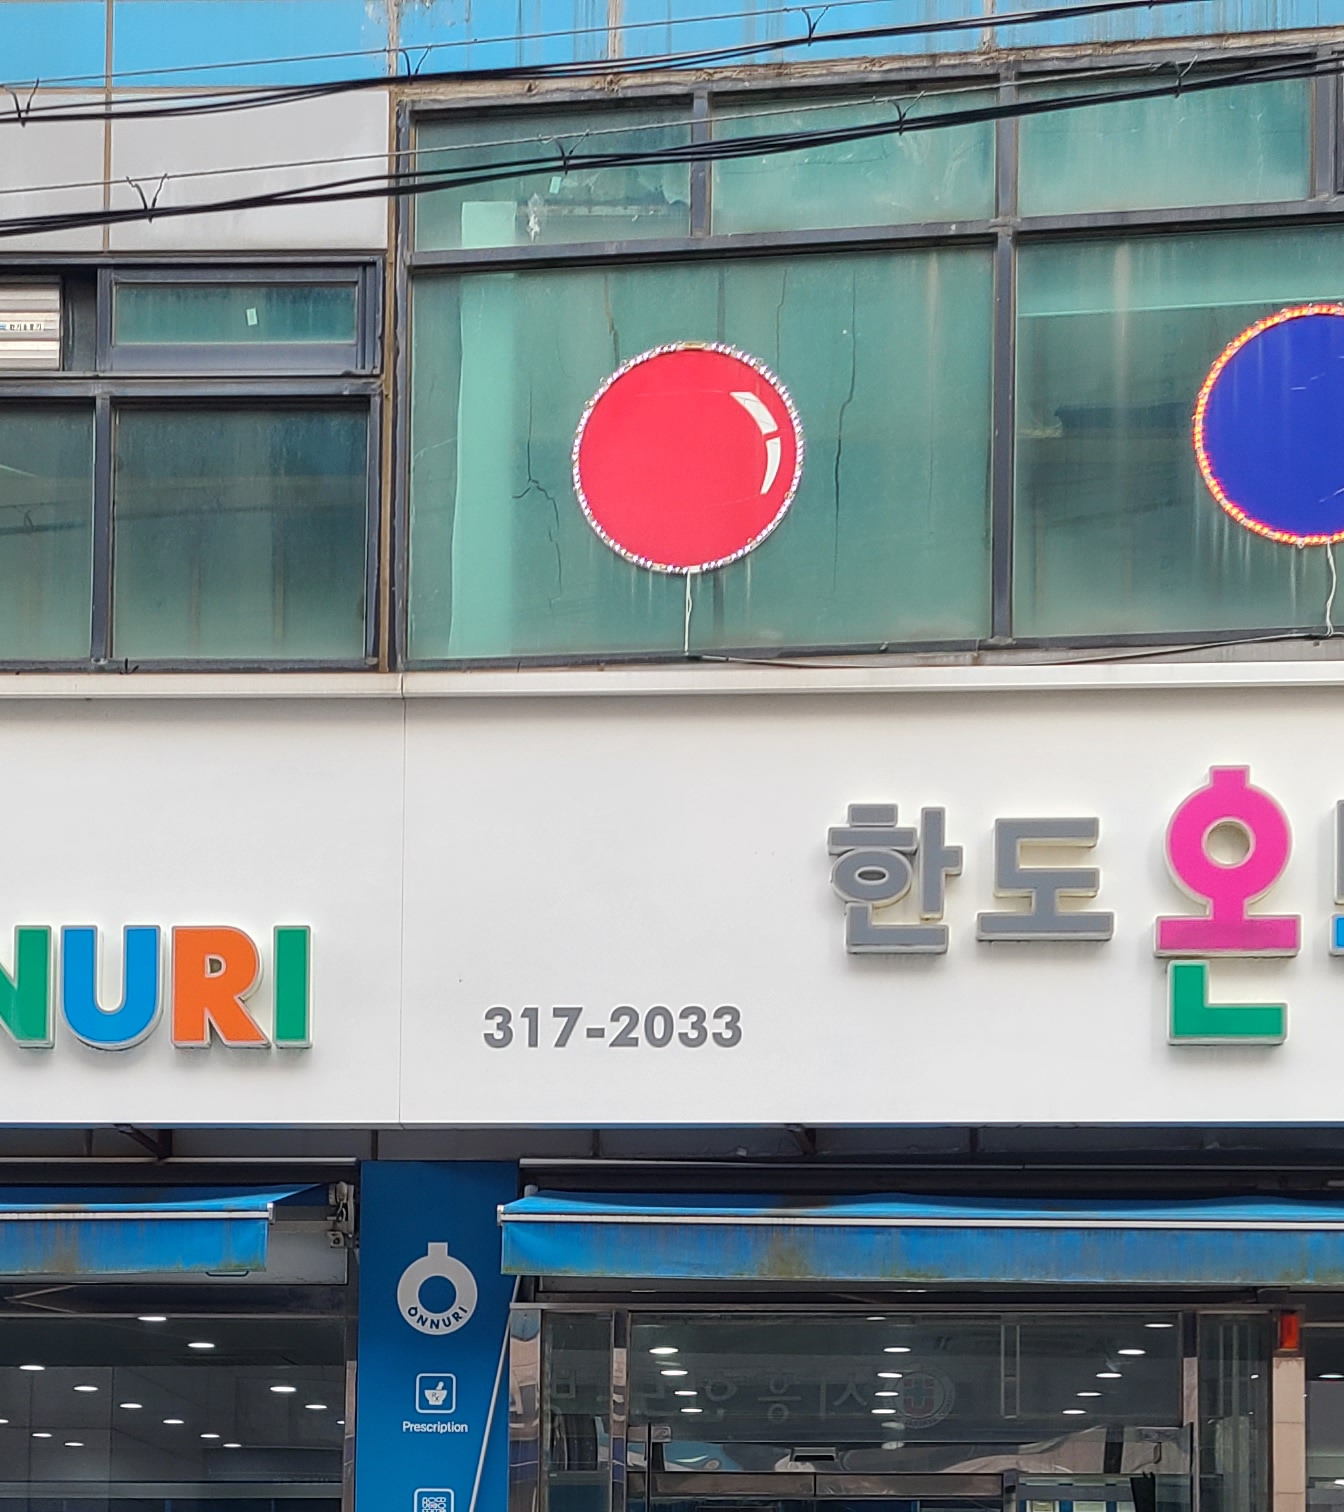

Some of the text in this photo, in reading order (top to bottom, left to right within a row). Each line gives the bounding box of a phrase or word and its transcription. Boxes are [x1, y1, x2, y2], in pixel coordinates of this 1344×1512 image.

[484, 1006, 742, 1048] 317-2033
[408, 1305, 469, 1330] ONNURI
[403, 1420, 468, 1434] Prescription
